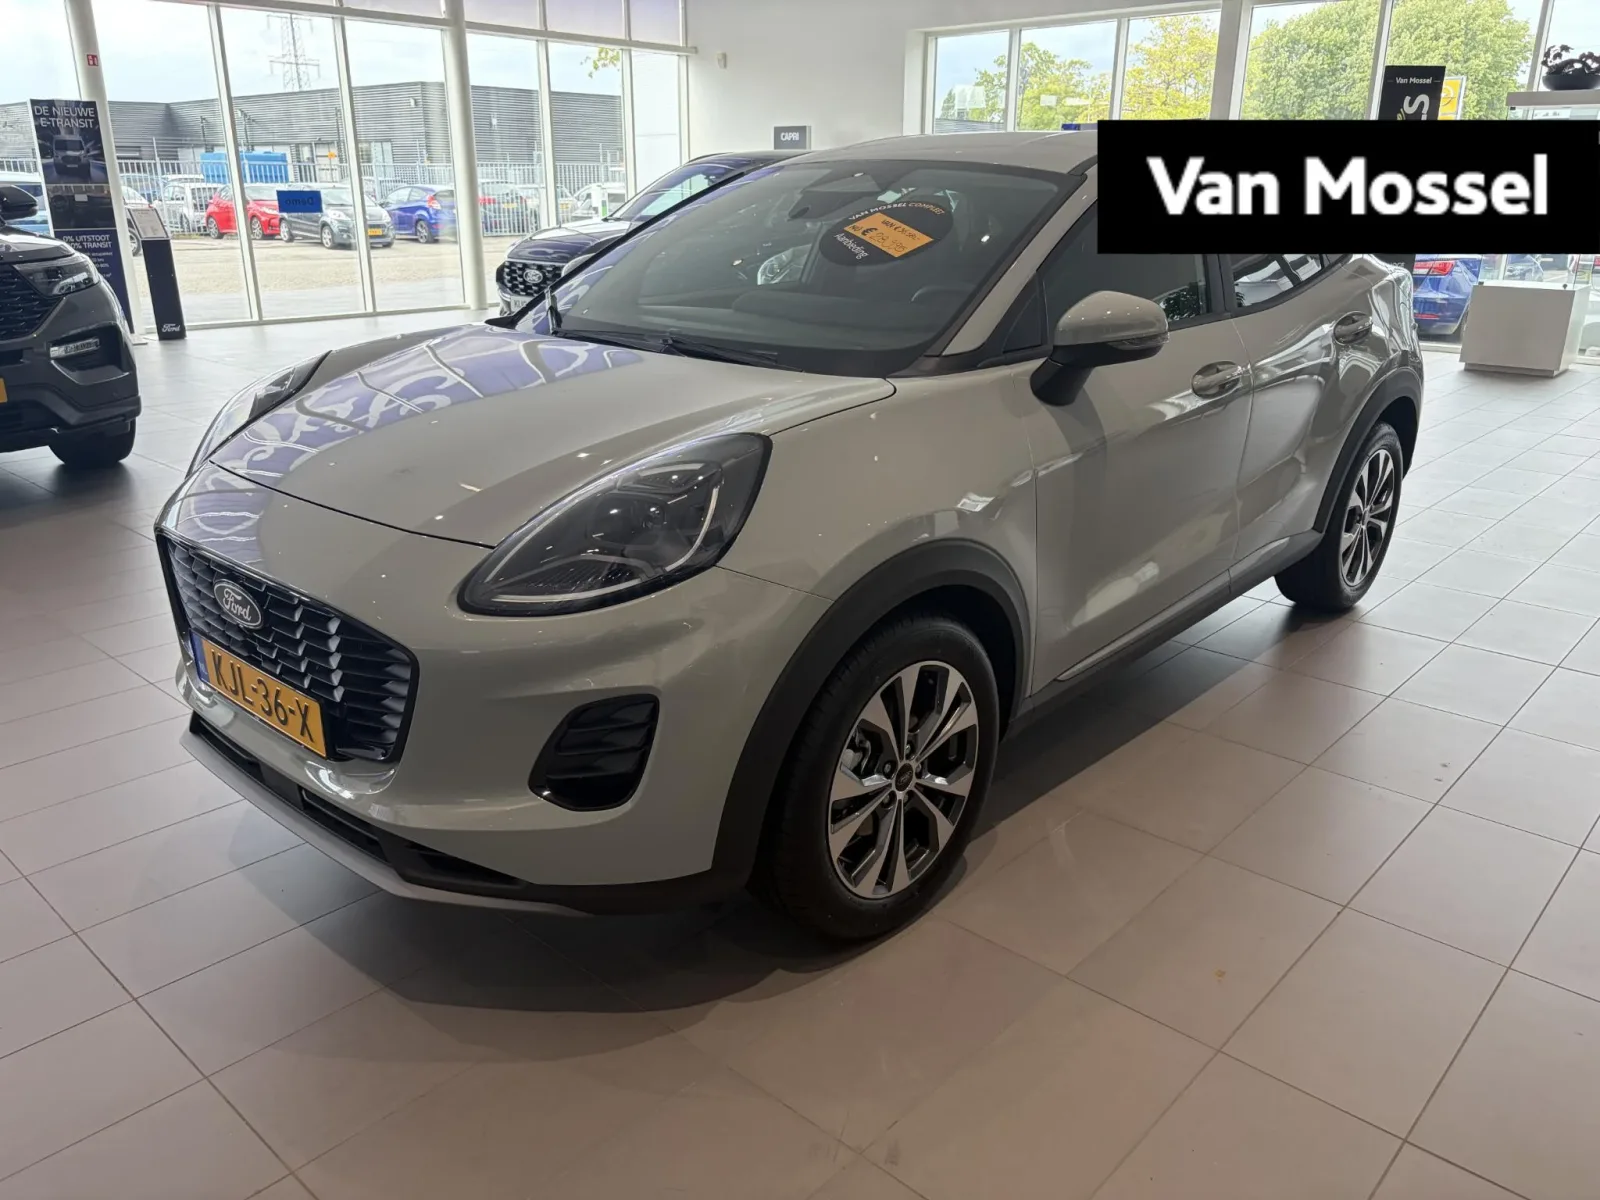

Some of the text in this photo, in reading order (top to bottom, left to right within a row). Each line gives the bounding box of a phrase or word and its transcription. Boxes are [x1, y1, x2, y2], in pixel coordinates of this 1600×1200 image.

[1395, 76, 1433, 84] Van Mossel
[34, 105, 95, 117] DE NIEUWE
[40, 117, 94, 129] E-TRANSIT
[780, 131, 800, 141] CAPRI
[848, 210, 869, 220] VAN
[870, 202, 907, 213] MOSSEL
[75, 234, 110, 242] UITSTOOT
[82, 241, 112, 249] TRANSIT
[833, 232, 869, 260] Aanbieding
[162, 323, 180, 333] Ford
[222, 588, 252, 622] Ford
[211, 649, 315, 743] KJL-36-X
